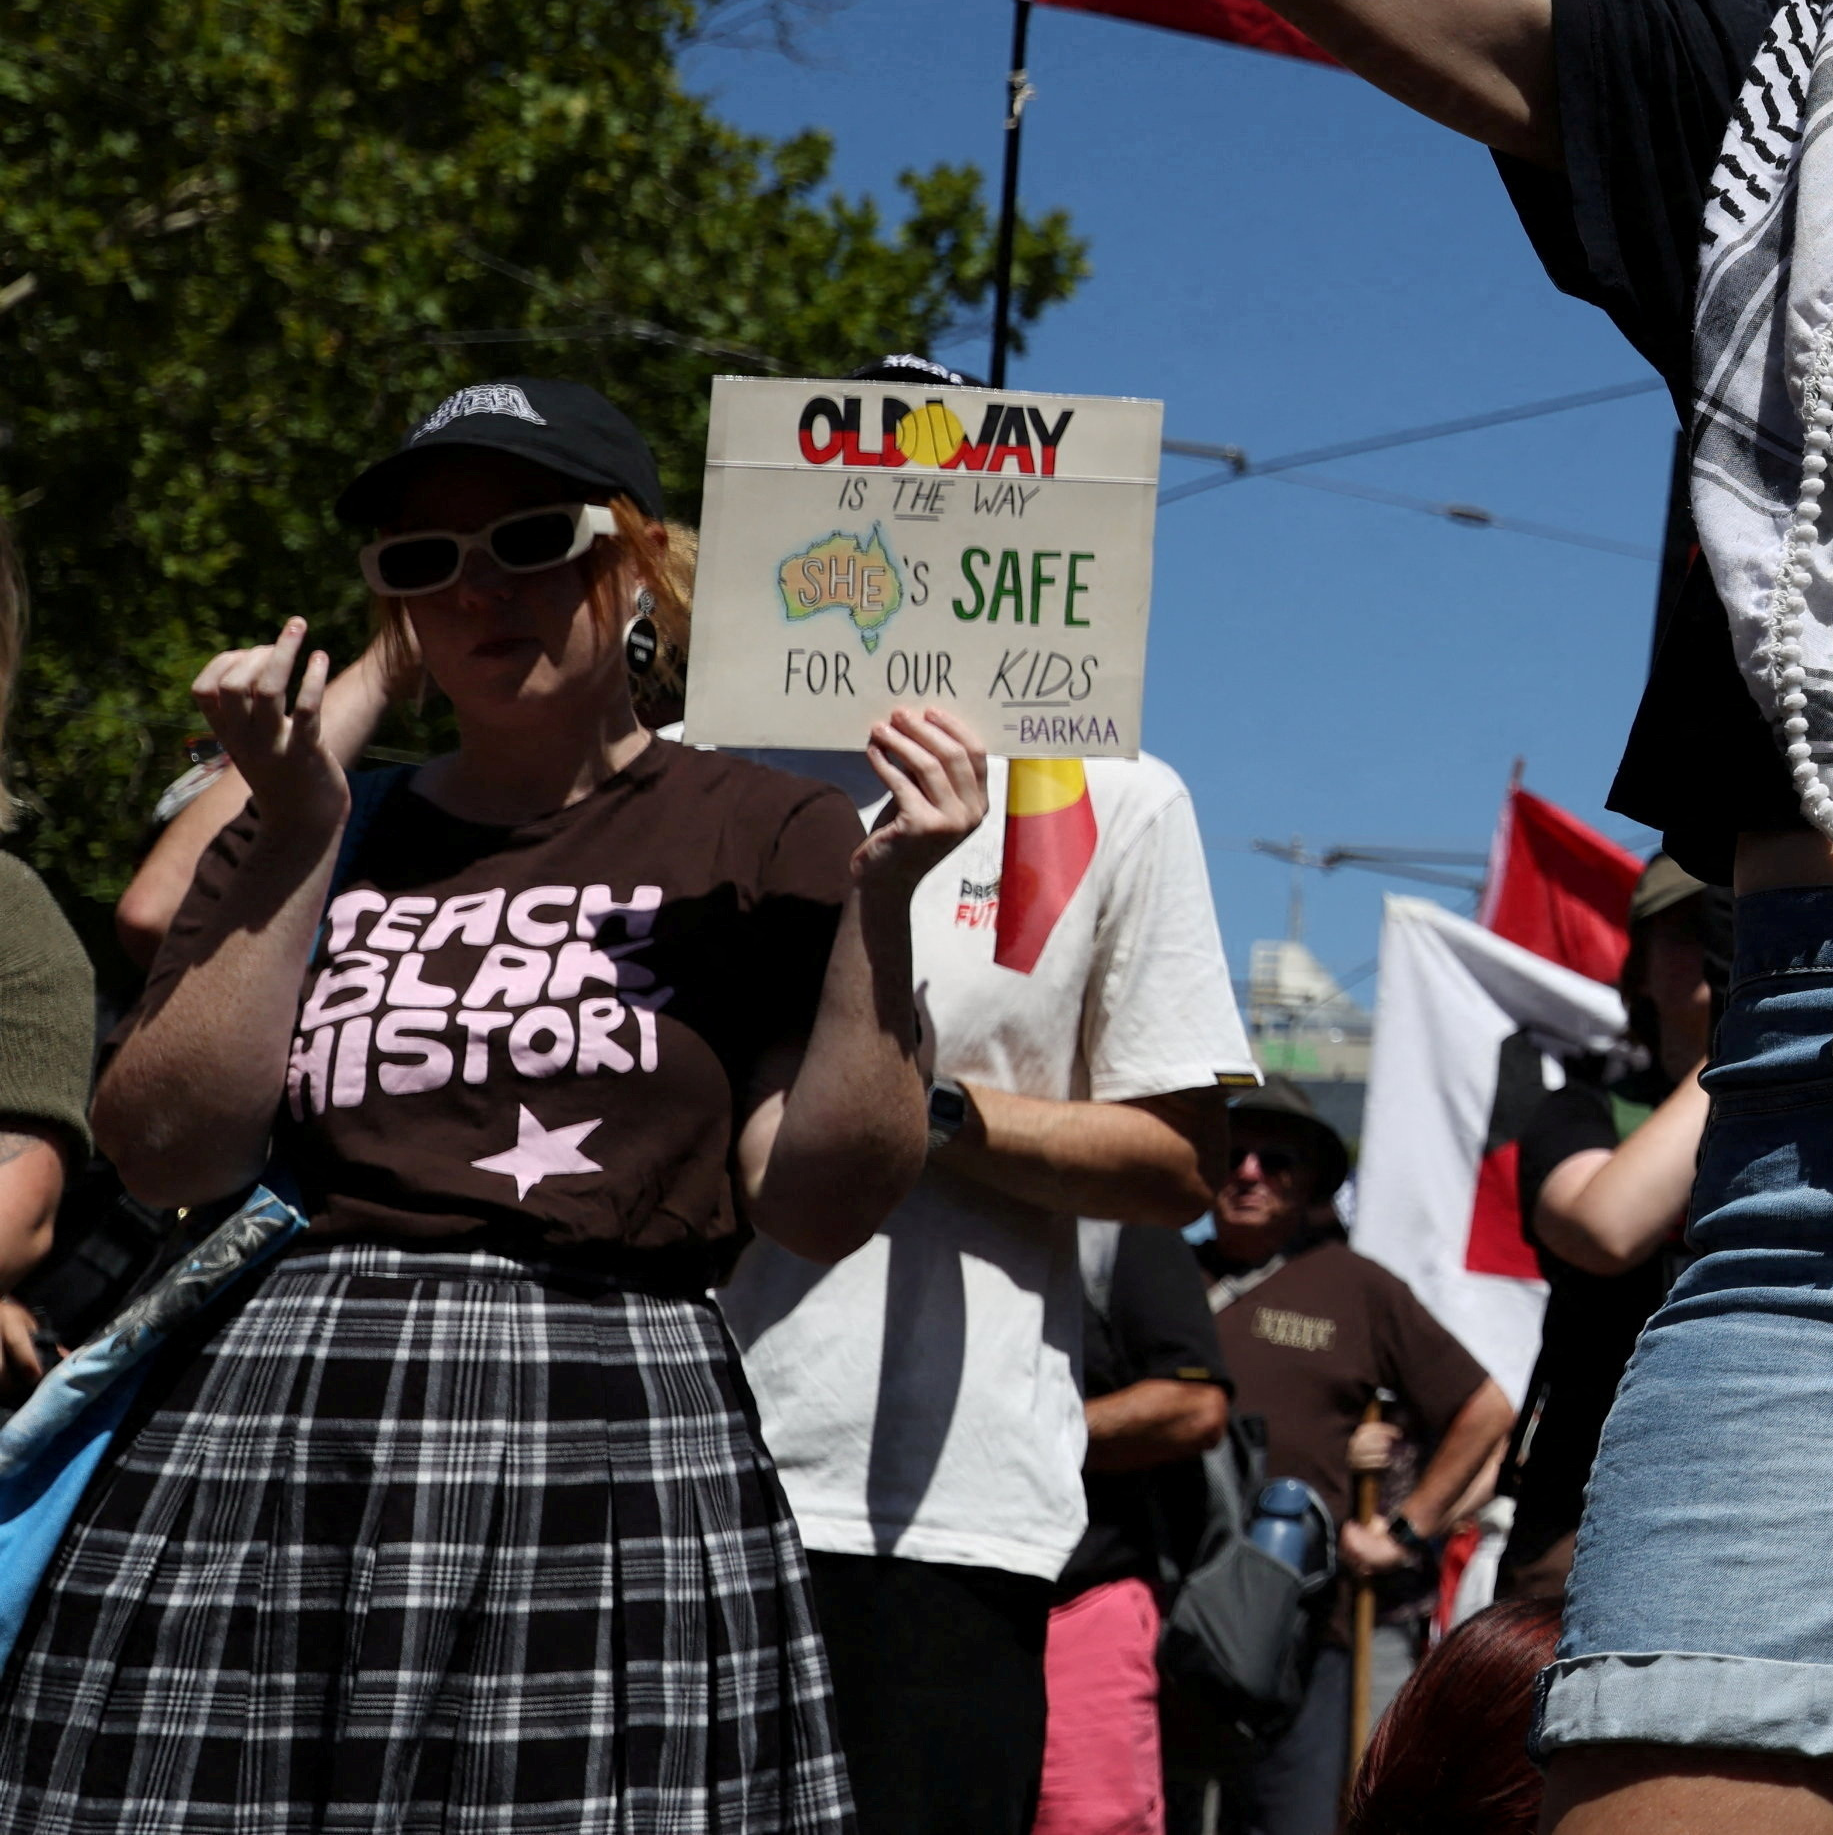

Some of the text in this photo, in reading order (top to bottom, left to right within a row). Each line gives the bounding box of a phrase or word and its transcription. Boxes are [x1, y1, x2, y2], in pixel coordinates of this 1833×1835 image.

[838, 477, 1041, 519] IS THE WAY
[952, 546, 1096, 627] SAFE
[784, 648, 1100, 701] FOR OUR KIDS
[327, 884, 663, 954] TEACH
[301, 938, 656, 1032] BLAK
[287, 987, 675, 1123] HISTORY
